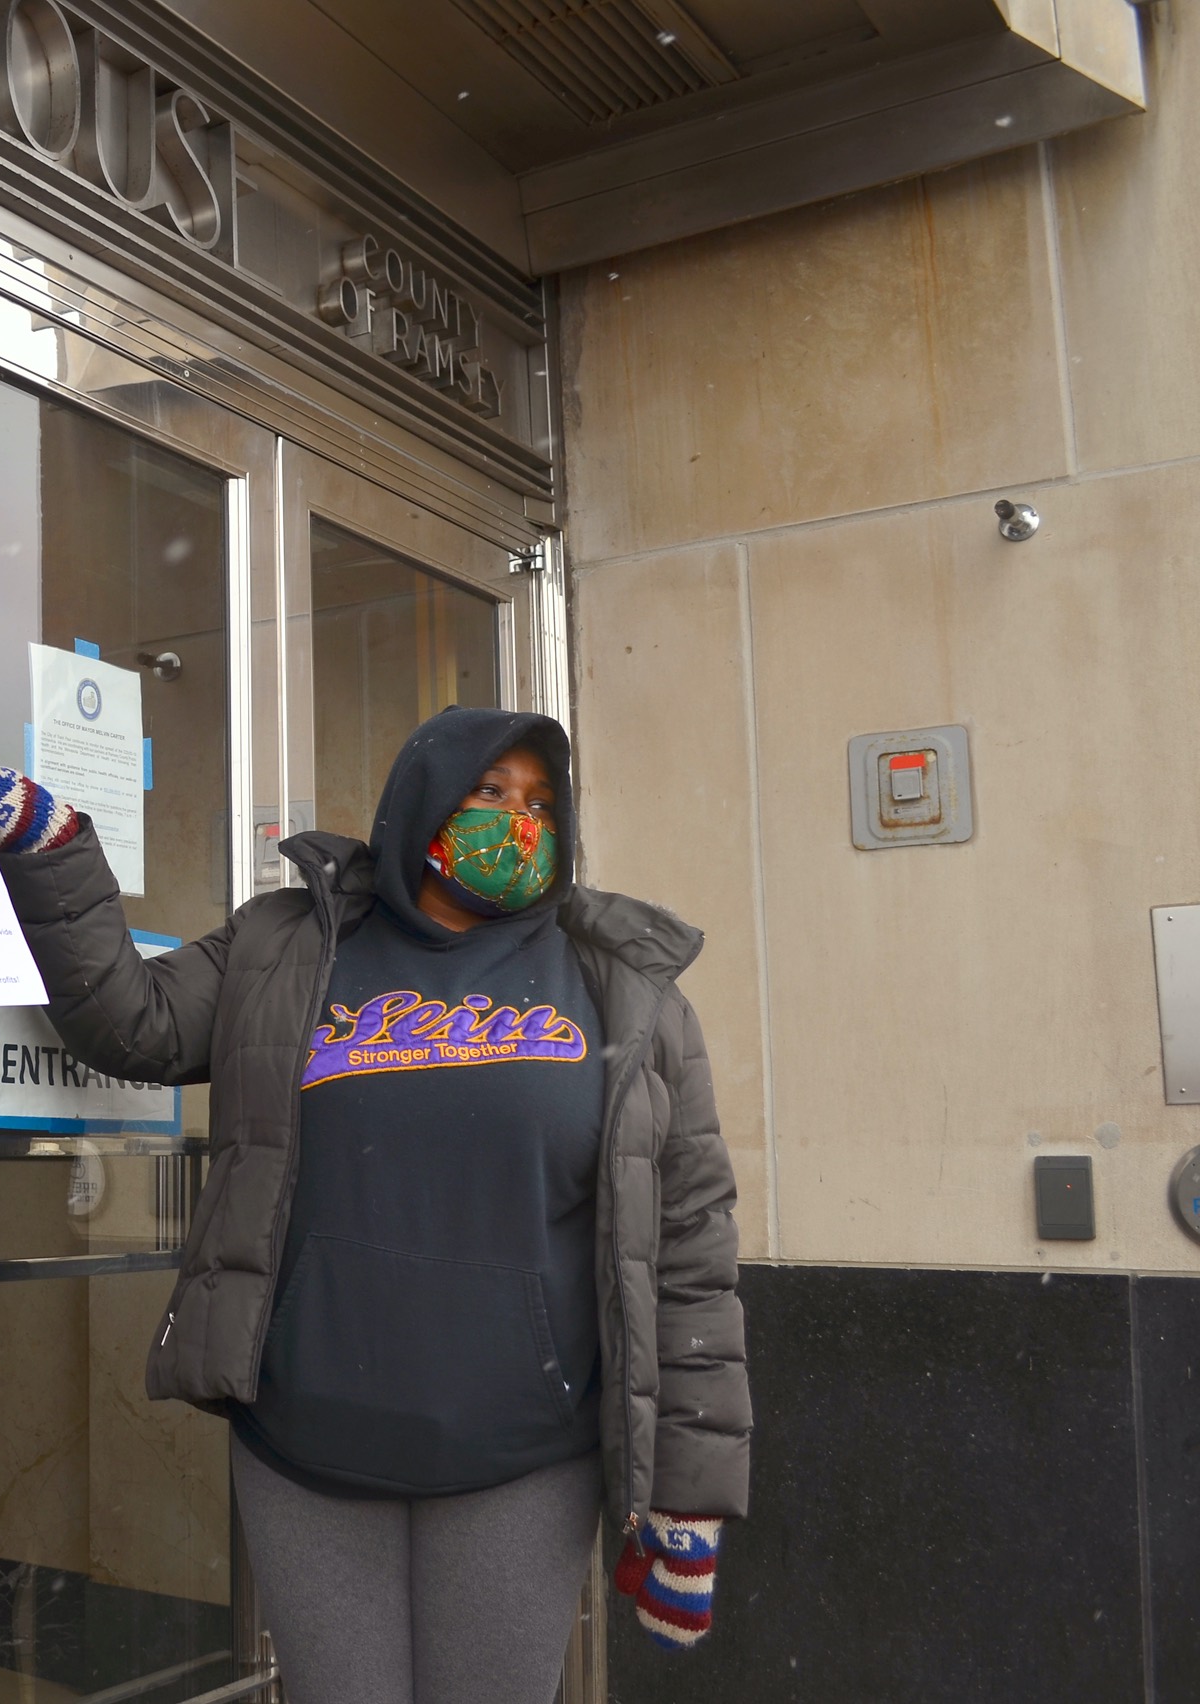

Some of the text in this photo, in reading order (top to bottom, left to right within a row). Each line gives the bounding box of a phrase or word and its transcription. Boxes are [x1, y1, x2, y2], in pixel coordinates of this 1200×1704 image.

[363, 233, 483, 348] COUNTY
[340, 276, 506, 416] OF RAMSEY
[53, 718, 61, 726] THE
[61, 721, 76, 730] OFFICE
[81, 726, 95, 734] MAYOR
[110, 732, 125, 741] CARTER
[348, 1042, 518, 1070] Stronger Together
